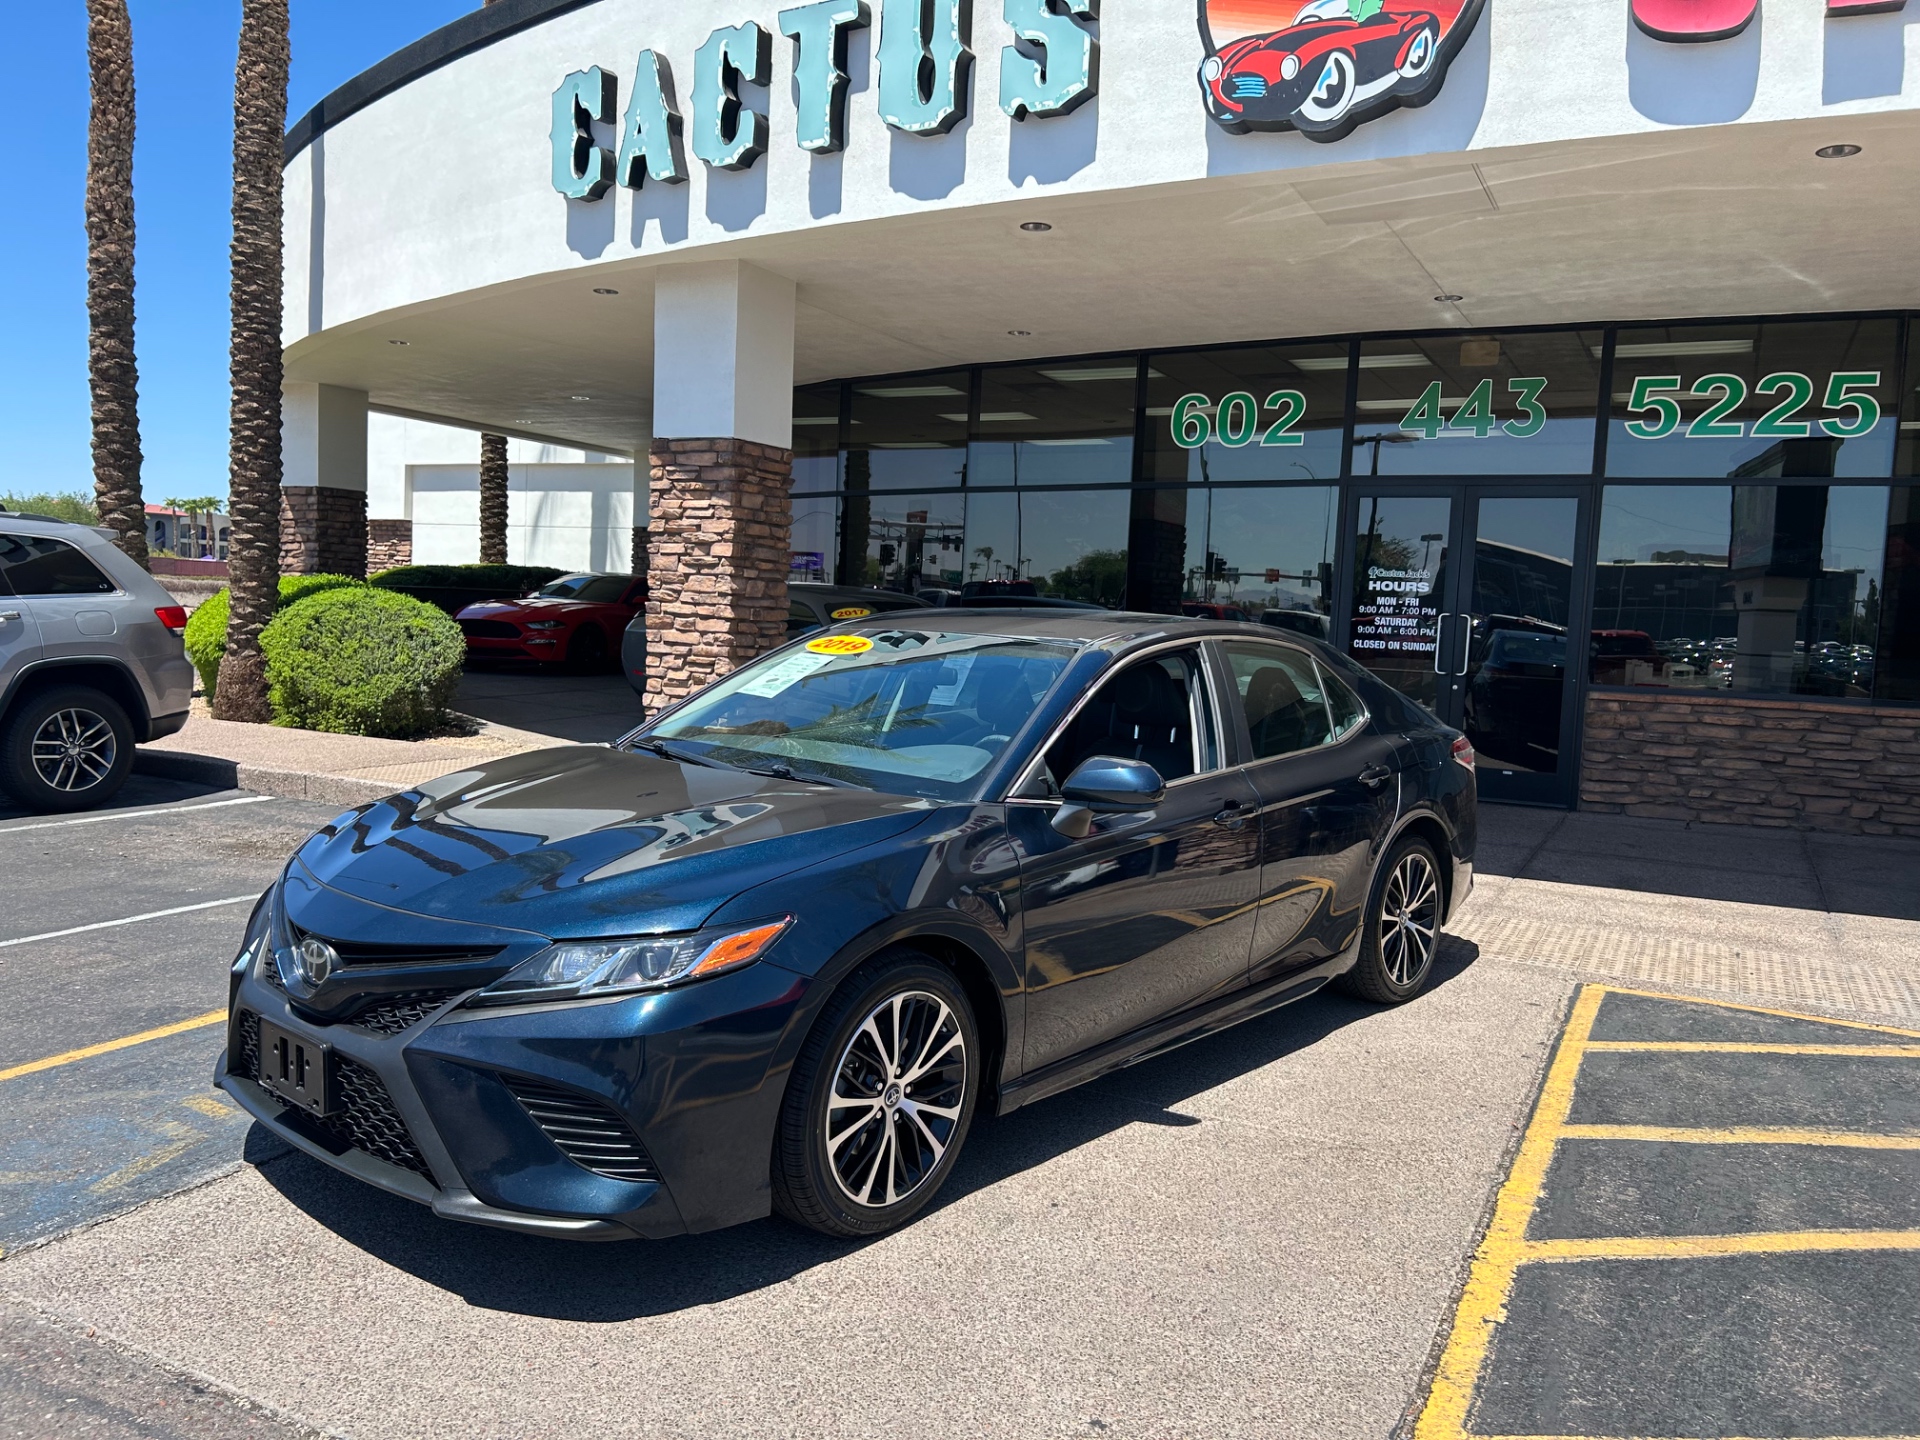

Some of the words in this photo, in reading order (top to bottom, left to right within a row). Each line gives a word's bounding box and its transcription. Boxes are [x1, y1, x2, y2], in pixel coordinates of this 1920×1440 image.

[549, 0, 1099, 202] CACTUS
[1170, 389, 1307, 450] 602
[1398, 376, 1549, 440] 443
[1624, 370, 1882, 440] 5225
[1368, 580, 1430, 593] HOURS
[1376, 596, 1397, 606] MON
[1405, 597, 1419, 606] FRI
[836, 609, 865, 619] 2017
[1358, 605, 1377, 614] 9:00
[1378, 606, 1393, 614] AM
[1401, 607, 1419, 615] 7:00
[1421, 607, 1437, 616] PM
[1374, 616, 1418, 627] SATURDAY
[1357, 625, 1376, 634] 9:00
[1376, 626, 1392, 634] AM
[1399, 627, 1418, 636] 6:00
[1419, 628, 1435, 636] PM
[809, 638, 868, 652] 2019
[1353, 639, 1386, 649] CLOSED
[1387, 641, 1400, 650] ON
[1401, 641, 1436, 651] SUNDAY
